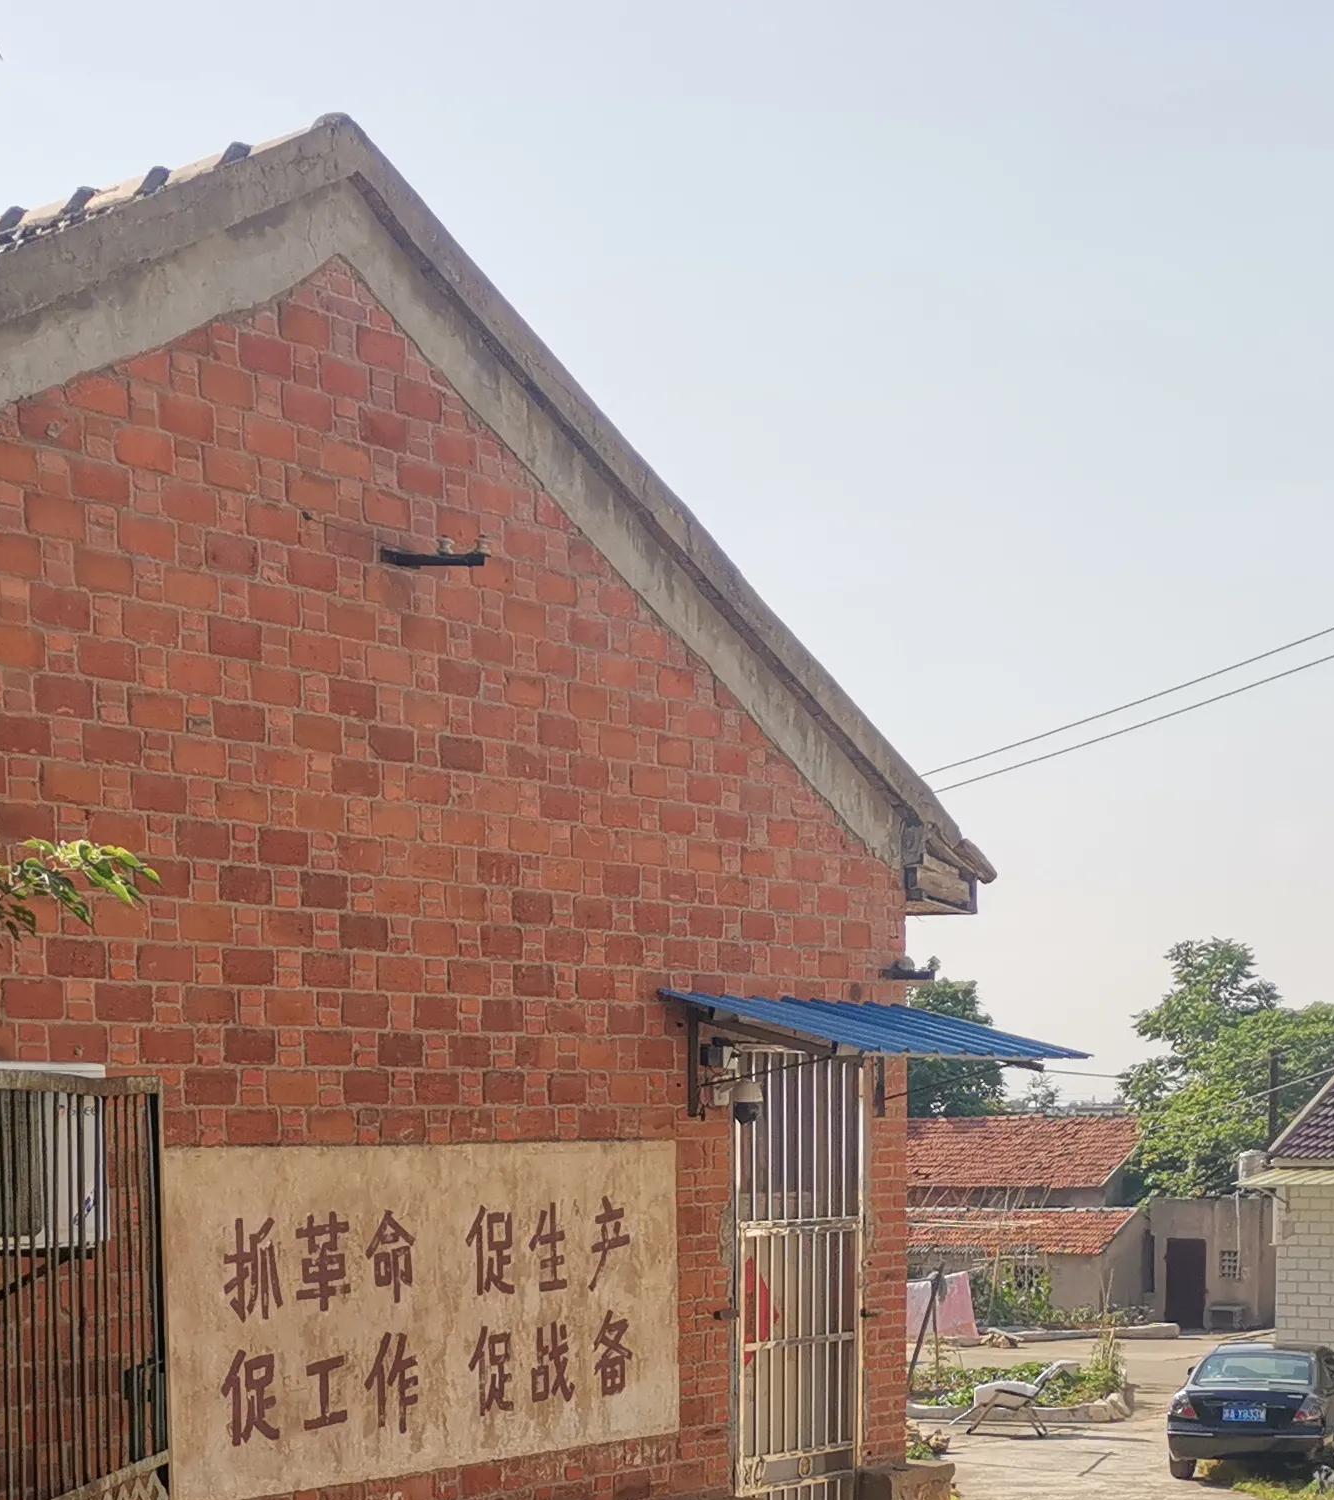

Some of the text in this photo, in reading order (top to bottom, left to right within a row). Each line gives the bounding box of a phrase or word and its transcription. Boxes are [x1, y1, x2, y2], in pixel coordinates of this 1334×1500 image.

[222, 1195, 632, 1322] 抓革命 促生产
[220, 1309, 634, 1447] 促工作 促战备
